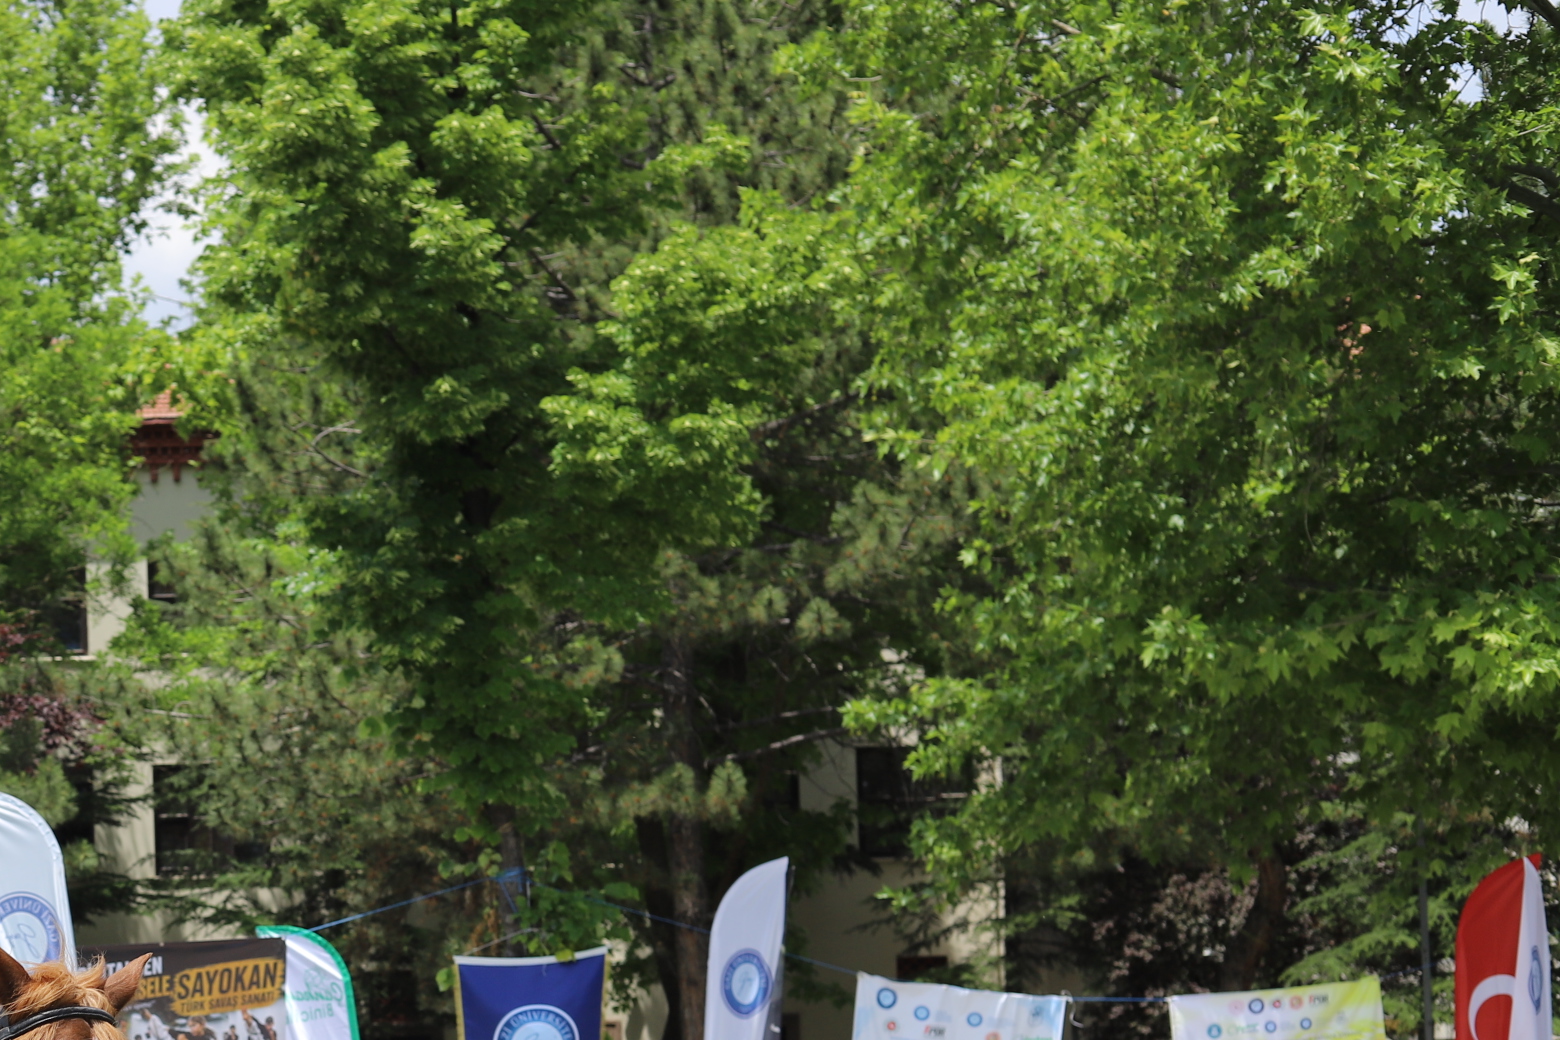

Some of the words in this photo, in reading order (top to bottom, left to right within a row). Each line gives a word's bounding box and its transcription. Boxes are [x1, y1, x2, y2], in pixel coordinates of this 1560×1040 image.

[177, 962, 278, 1000] SAYOKAN
[180, 1000, 205, 1013] TÜRK
[209, 997, 239, 1011] SAVAŞ
